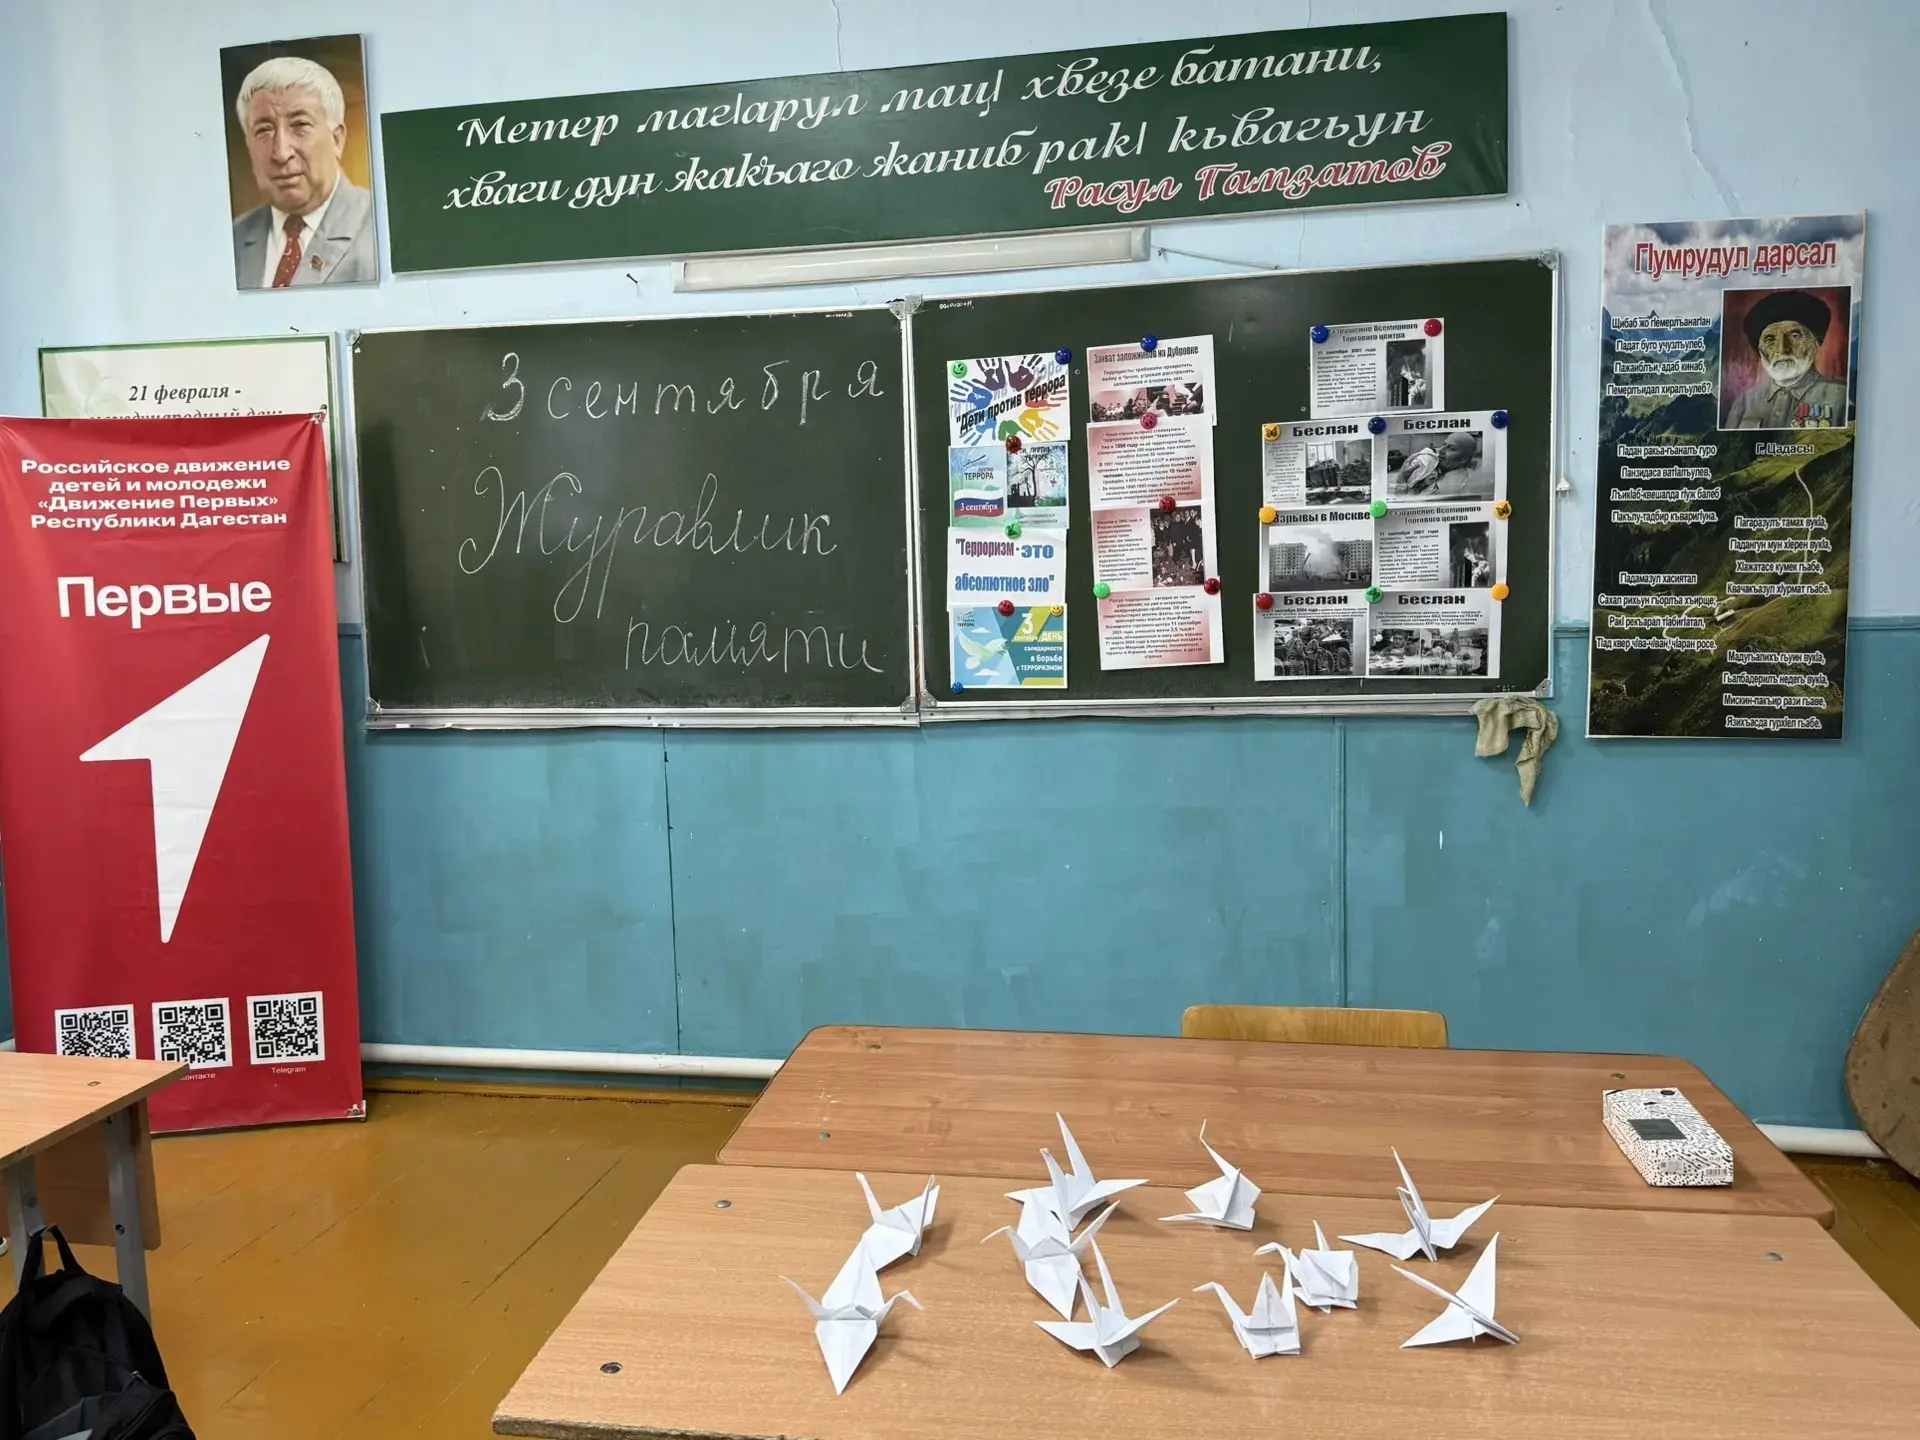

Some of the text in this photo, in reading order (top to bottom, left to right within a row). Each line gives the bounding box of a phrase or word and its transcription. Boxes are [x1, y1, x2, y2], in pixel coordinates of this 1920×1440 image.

[457, 113, 619, 148] Метер
[1020, 57, 1163, 104] хвезе
[1170, 44, 1383, 88] батани,
[442, 170, 569, 210] хваги
[567, 171, 662, 209] дун
[664, 152, 860, 194] жакъаго
[862, 126, 1038, 179] жаниб
[1167, 106, 1434, 155] кьвагьун
[1043, 141, 1453, 214] Расул Гамзатов
[1753, 242, 1836, 274] дарсал
[1612, 317, 1637, 330] Щибаб
[1639, 319, 1649, 328] жо
[1641, 339, 1657, 352] буго
[1662, 361, 1679, 373] адаб
[1681, 360, 1705, 373] кинаб,
[128, 385, 148, 402] 21
[154, 385, 229, 404] февраля
[487, 352, 885, 426] 3 сентября
[988, 394, 1021, 421] против
[1293, 424, 1359, 437] Беслан
[1403, 418, 1471, 430] Беслан
[21, 458, 291, 475] Российское движение
[965, 472, 994, 480] ТЕРРОРА
[49, 477, 267, 494] детей и молодежи
[1697, 487, 1721, 500] балеб
[38, 494, 279, 513] «Движение Первых»
[960, 502, 998, 513] 3 сентября
[31, 511, 288, 531] Республики Дагестан
[1320, 513, 1327, 521] в
[1329, 511, 1370, 521] Москве
[1782, 518, 1804, 528] тамах
[457, 465, 838, 624] Журавлик
[955, 538, 1014, 558] "Терроризм
[1767, 540, 1782, 553] мун
[1776, 562, 1798, 575] кумек
[955, 573, 1054, 592] абсолютное зло"
[1663, 574, 1697, 584] хасиятал
[57, 575, 273, 630] Первые
[1283, 595, 1348, 605] Беслан
[1398, 594, 1465, 605] Беслан
[1598, 594, 1621, 606] Сахал
[1021, 612, 1034, 635] 3
[1041, 632, 1063, 642] ДЕНЬ
[625, 616, 886, 674] памяти
[1036, 654, 1063, 663] борьбе
[1783, 697, 1801, 709] рази
[271, 1066, 306, 1074] Telegram
